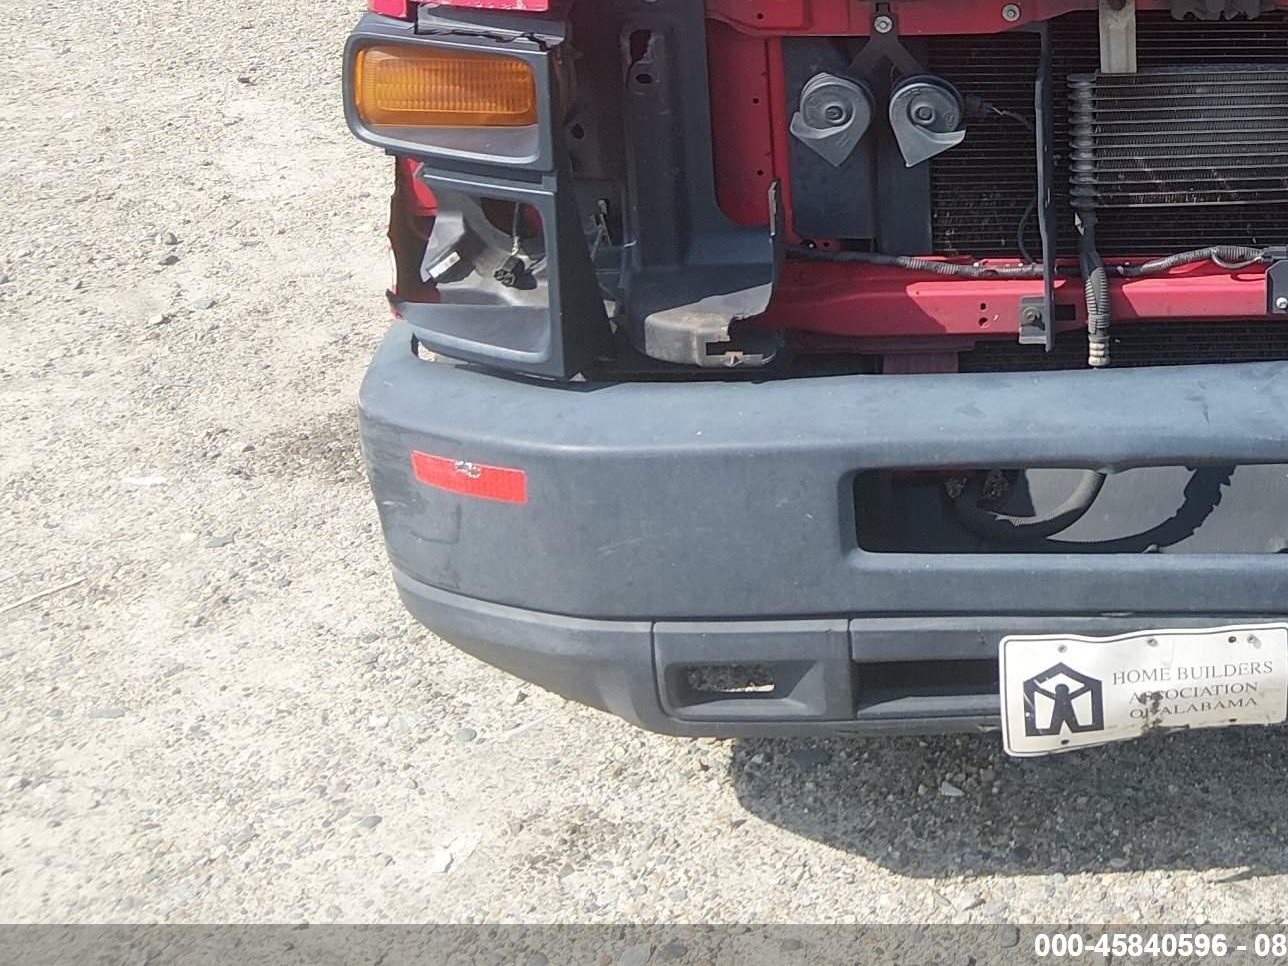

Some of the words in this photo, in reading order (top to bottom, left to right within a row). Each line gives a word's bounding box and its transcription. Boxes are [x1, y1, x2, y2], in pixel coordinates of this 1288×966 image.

[1113, 666, 1171, 685] HOME
[1177, 660, 1273, 680] BUILDERS
[1160, 696, 1257, 716] ALABAMA
